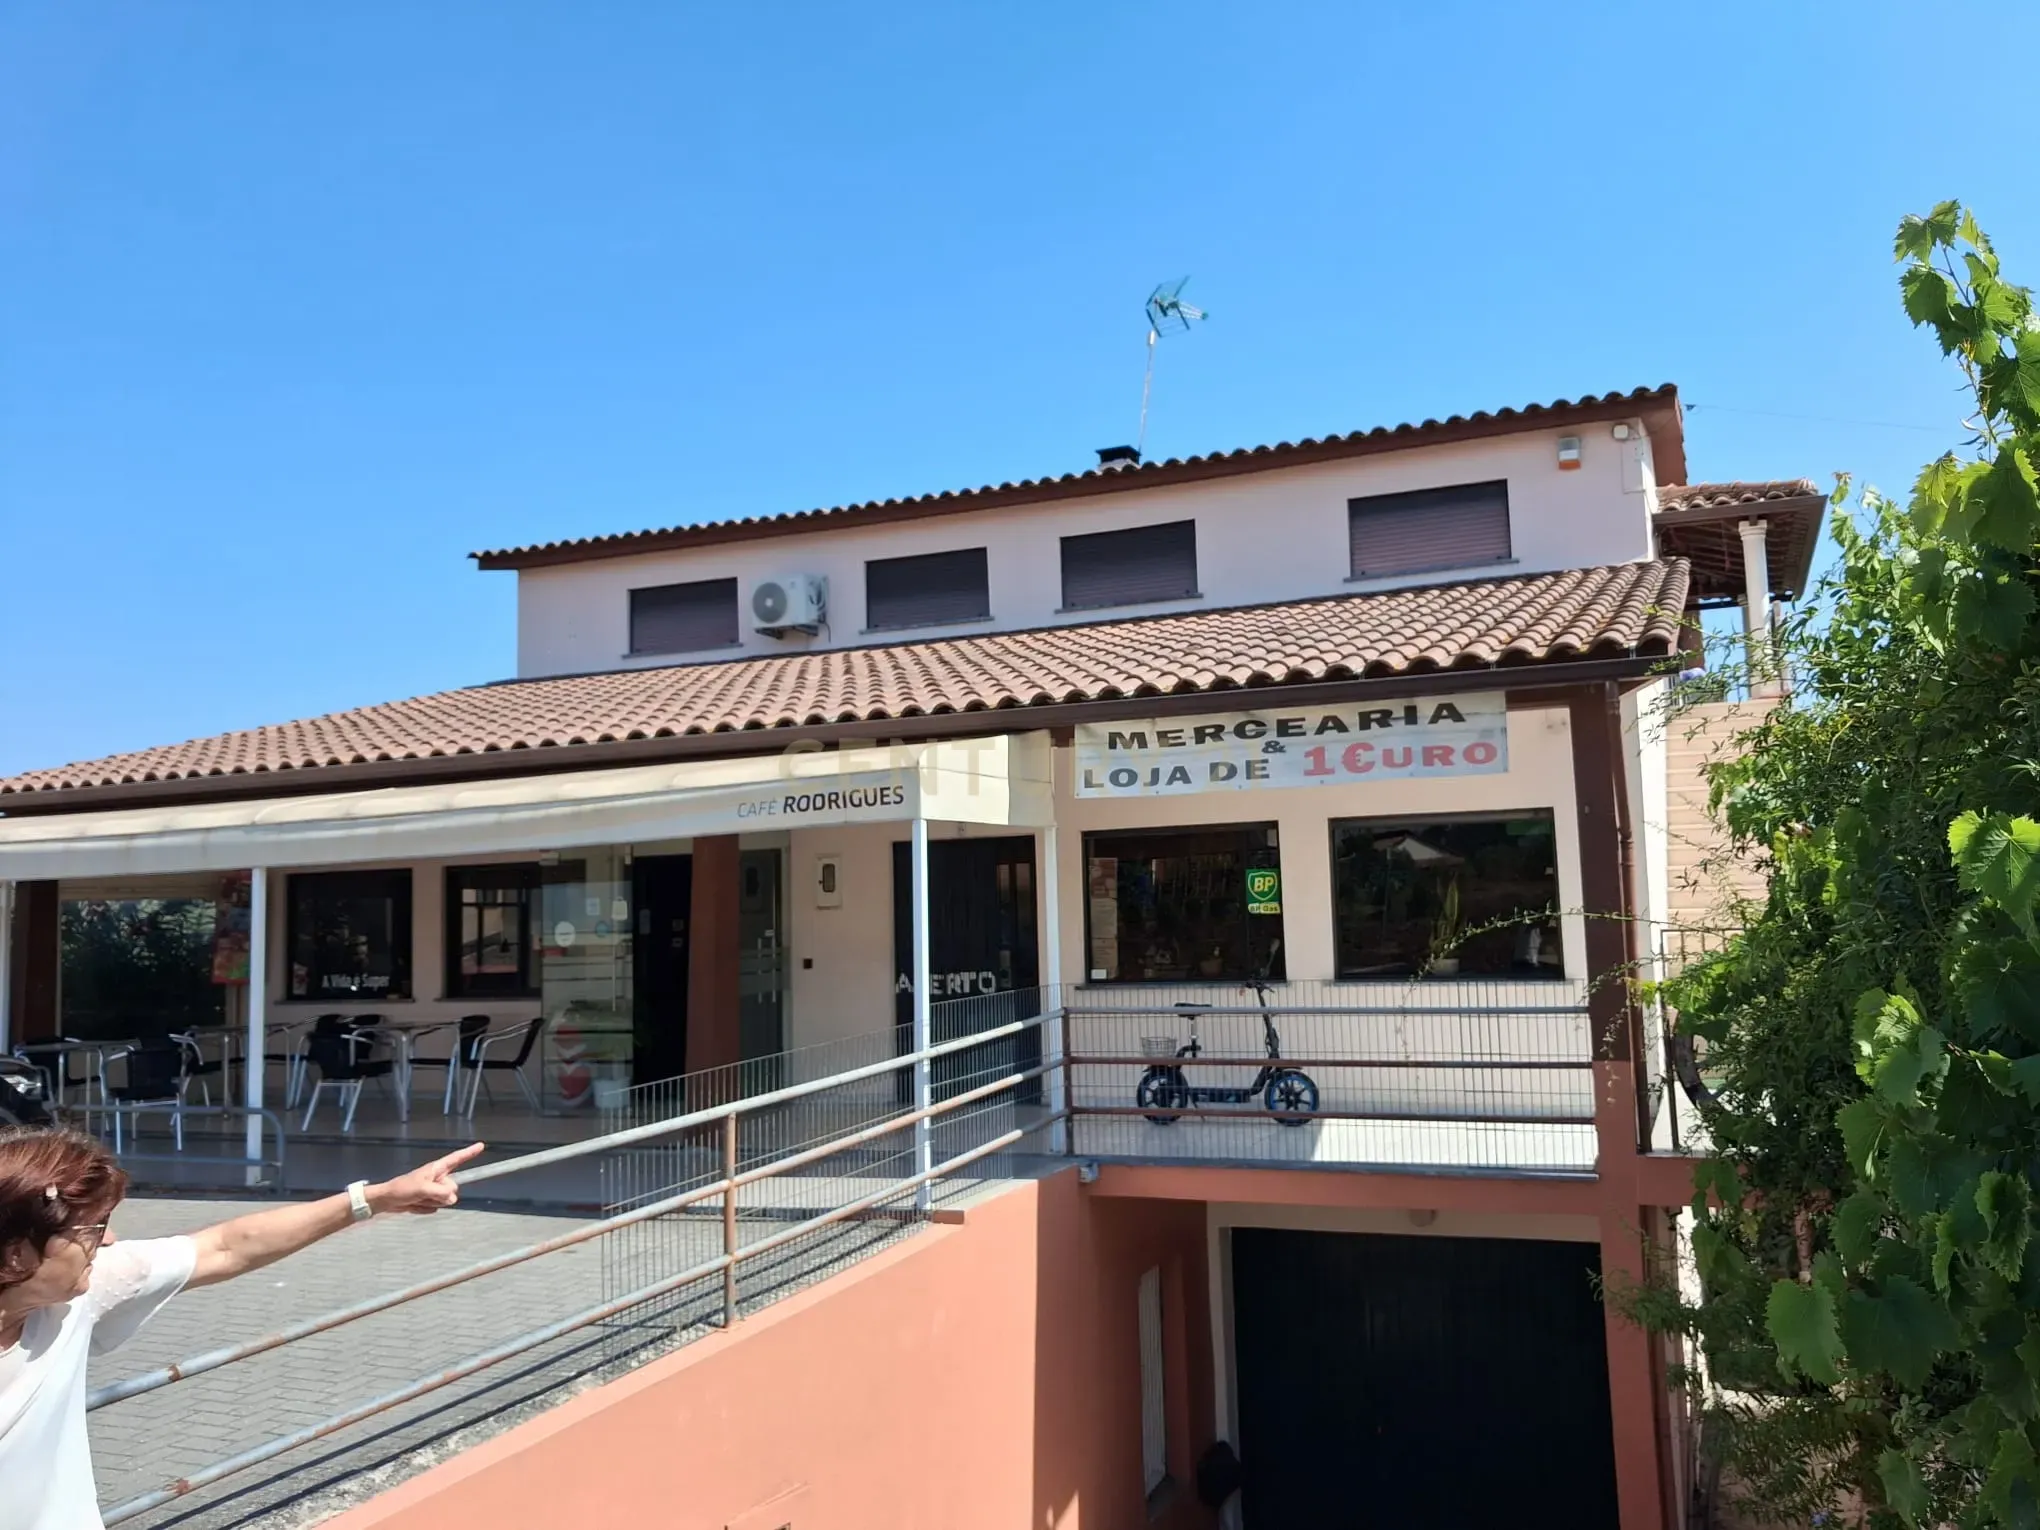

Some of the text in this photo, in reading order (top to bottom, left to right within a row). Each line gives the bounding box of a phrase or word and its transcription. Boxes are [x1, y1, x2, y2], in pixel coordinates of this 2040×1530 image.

[1108, 702, 1466, 750] MERCEARIA
[1261, 740, 1287, 754] &
[1083, 765, 1192, 789] LOJA
[1209, 758, 1270, 782] DE
[737, 786, 904, 818] CAFÉ RODRIGUES
[1254, 876, 1275, 892] BP
[895, 972, 996, 995] AERTO
